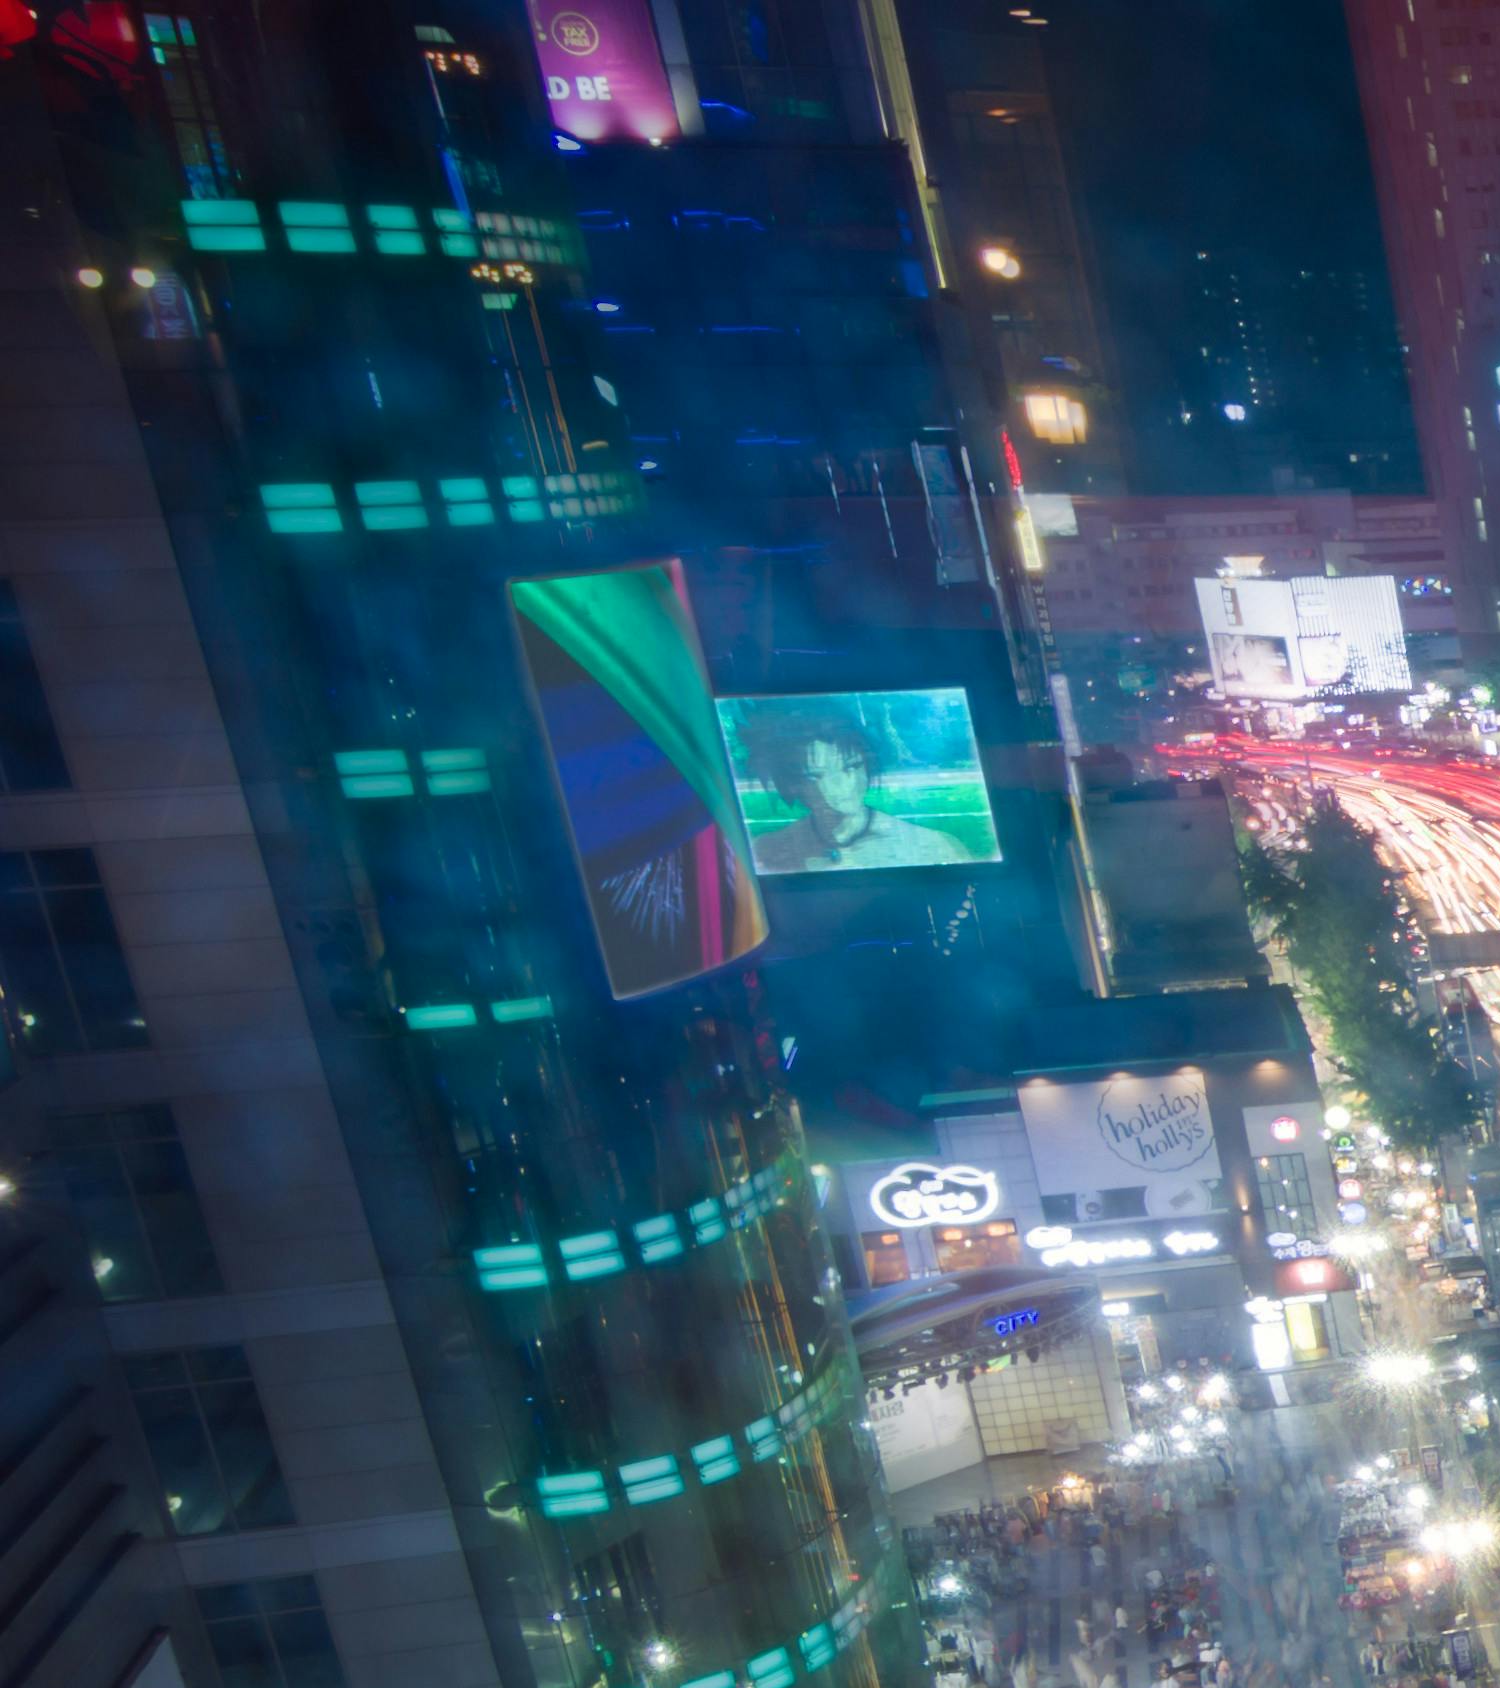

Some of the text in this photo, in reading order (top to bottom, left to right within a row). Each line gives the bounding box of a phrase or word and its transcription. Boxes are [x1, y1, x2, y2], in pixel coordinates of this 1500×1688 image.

[575, 76, 612, 101] BE
[1104, 1092, 1200, 1143] holiday
[995, 1311, 1039, 1335] CITY
